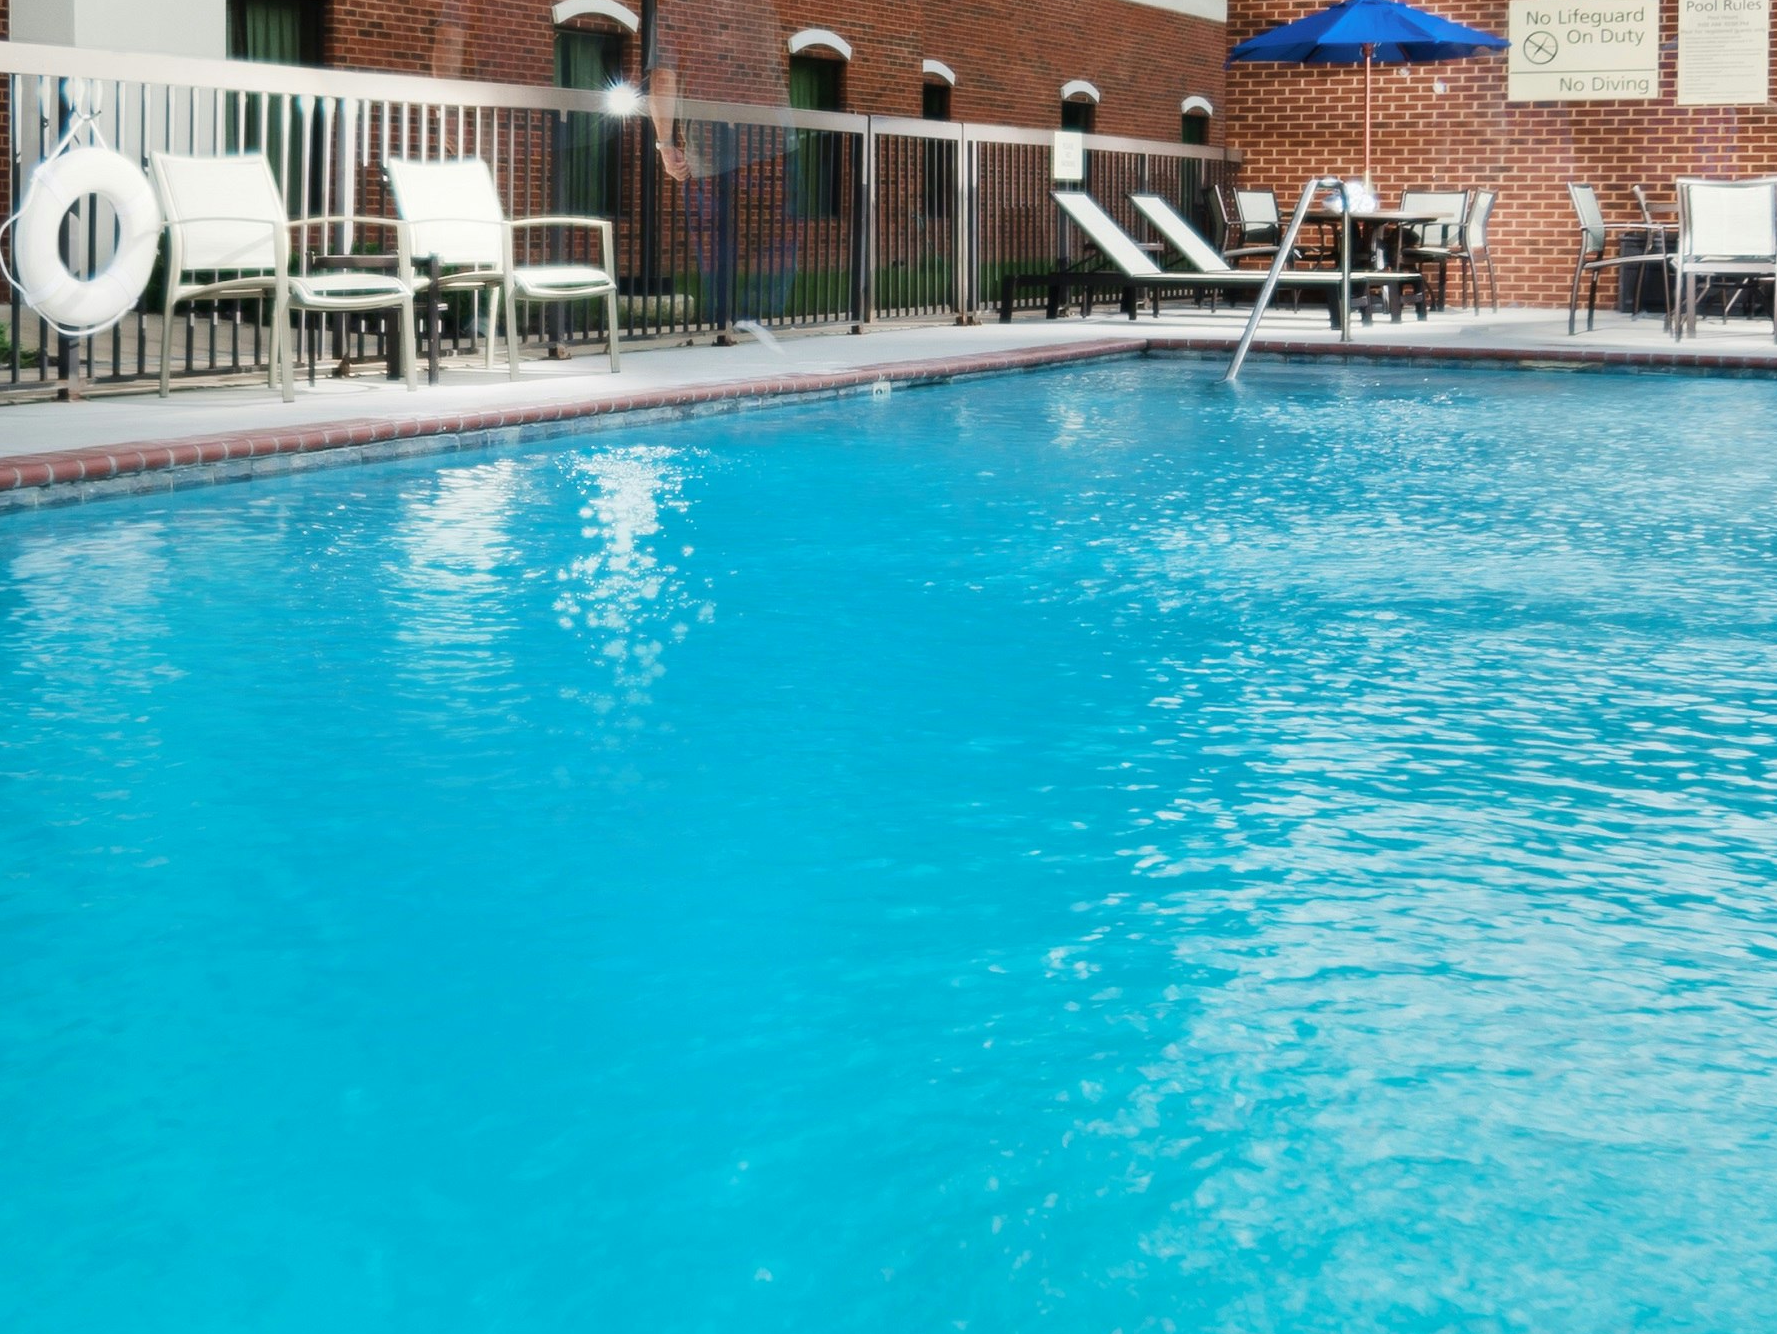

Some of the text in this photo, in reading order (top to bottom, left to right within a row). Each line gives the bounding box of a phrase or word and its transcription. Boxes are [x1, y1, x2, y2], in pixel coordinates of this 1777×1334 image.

[1686, 0, 1717, 12] Pool
[1526, 6, 1645, 27] No Lifeguard
[1566, 28, 1645, 46] On Duty
[1559, 75, 1649, 94] No Diving
